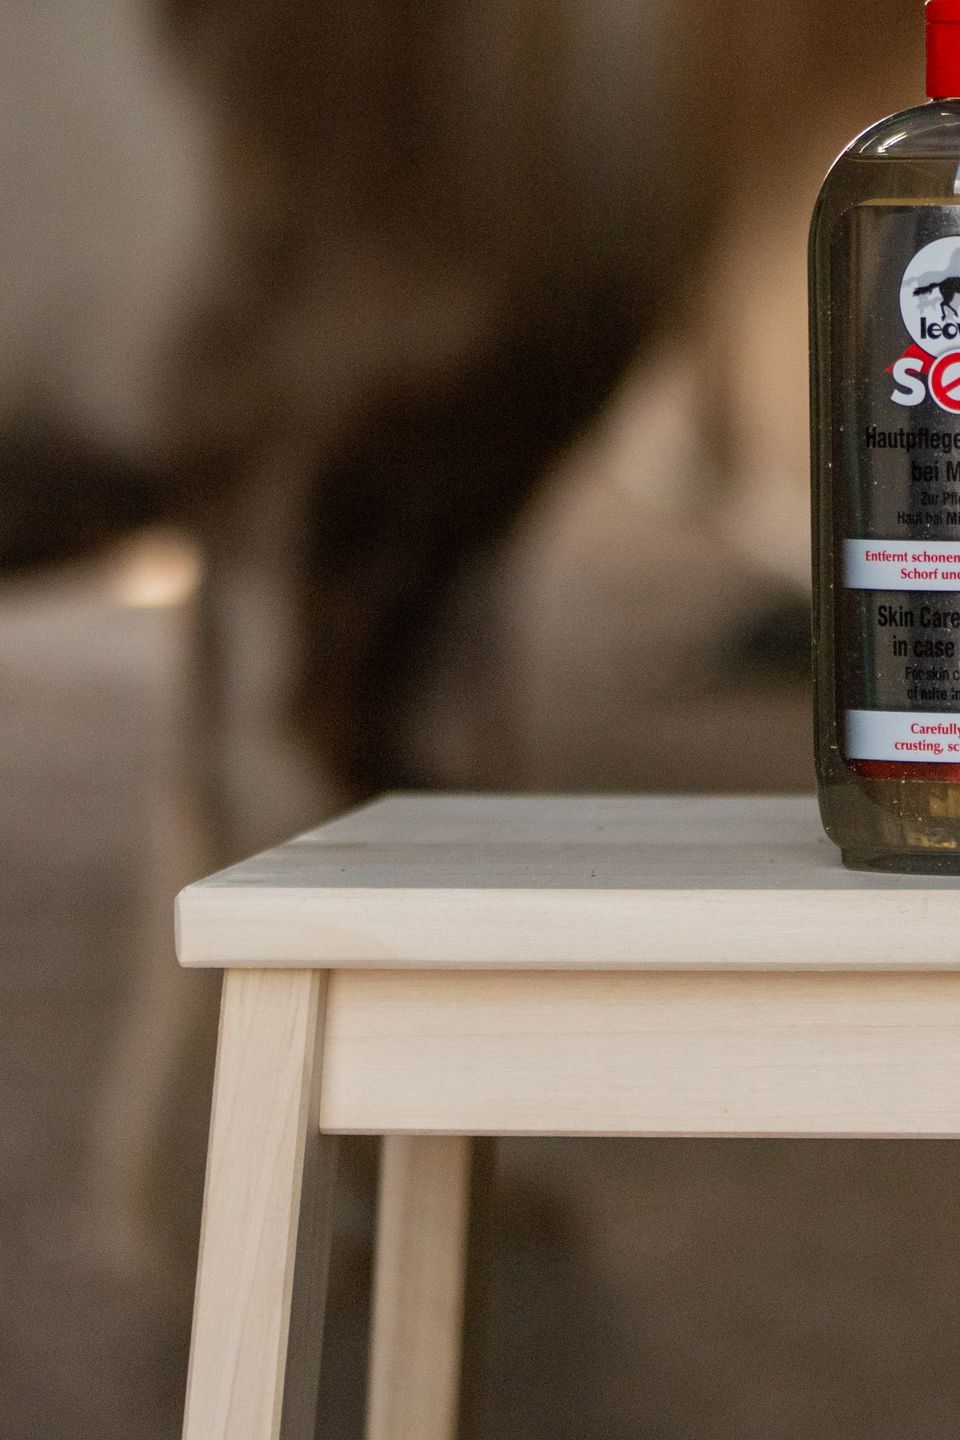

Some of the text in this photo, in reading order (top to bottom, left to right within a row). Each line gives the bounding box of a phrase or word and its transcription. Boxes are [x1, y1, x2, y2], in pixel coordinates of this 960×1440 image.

[912, 461, 938, 482] bei
[920, 492, 939, 505] Zur
[898, 511, 922, 525] Haut
[866, 550, 908, 562] Entfernt
[900, 568, 938, 580] Schorf
[878, 606, 914, 628] Skin
[920, 607, 960, 628] Care
[893, 636, 907, 656] in
[914, 640, 954, 658] case
[906, 667, 923, 680] For
[926, 667, 949, 681] skin
[908, 688, 919, 700] of
[920, 688, 947, 700] mite
[895, 740, 944, 754] crusting,
